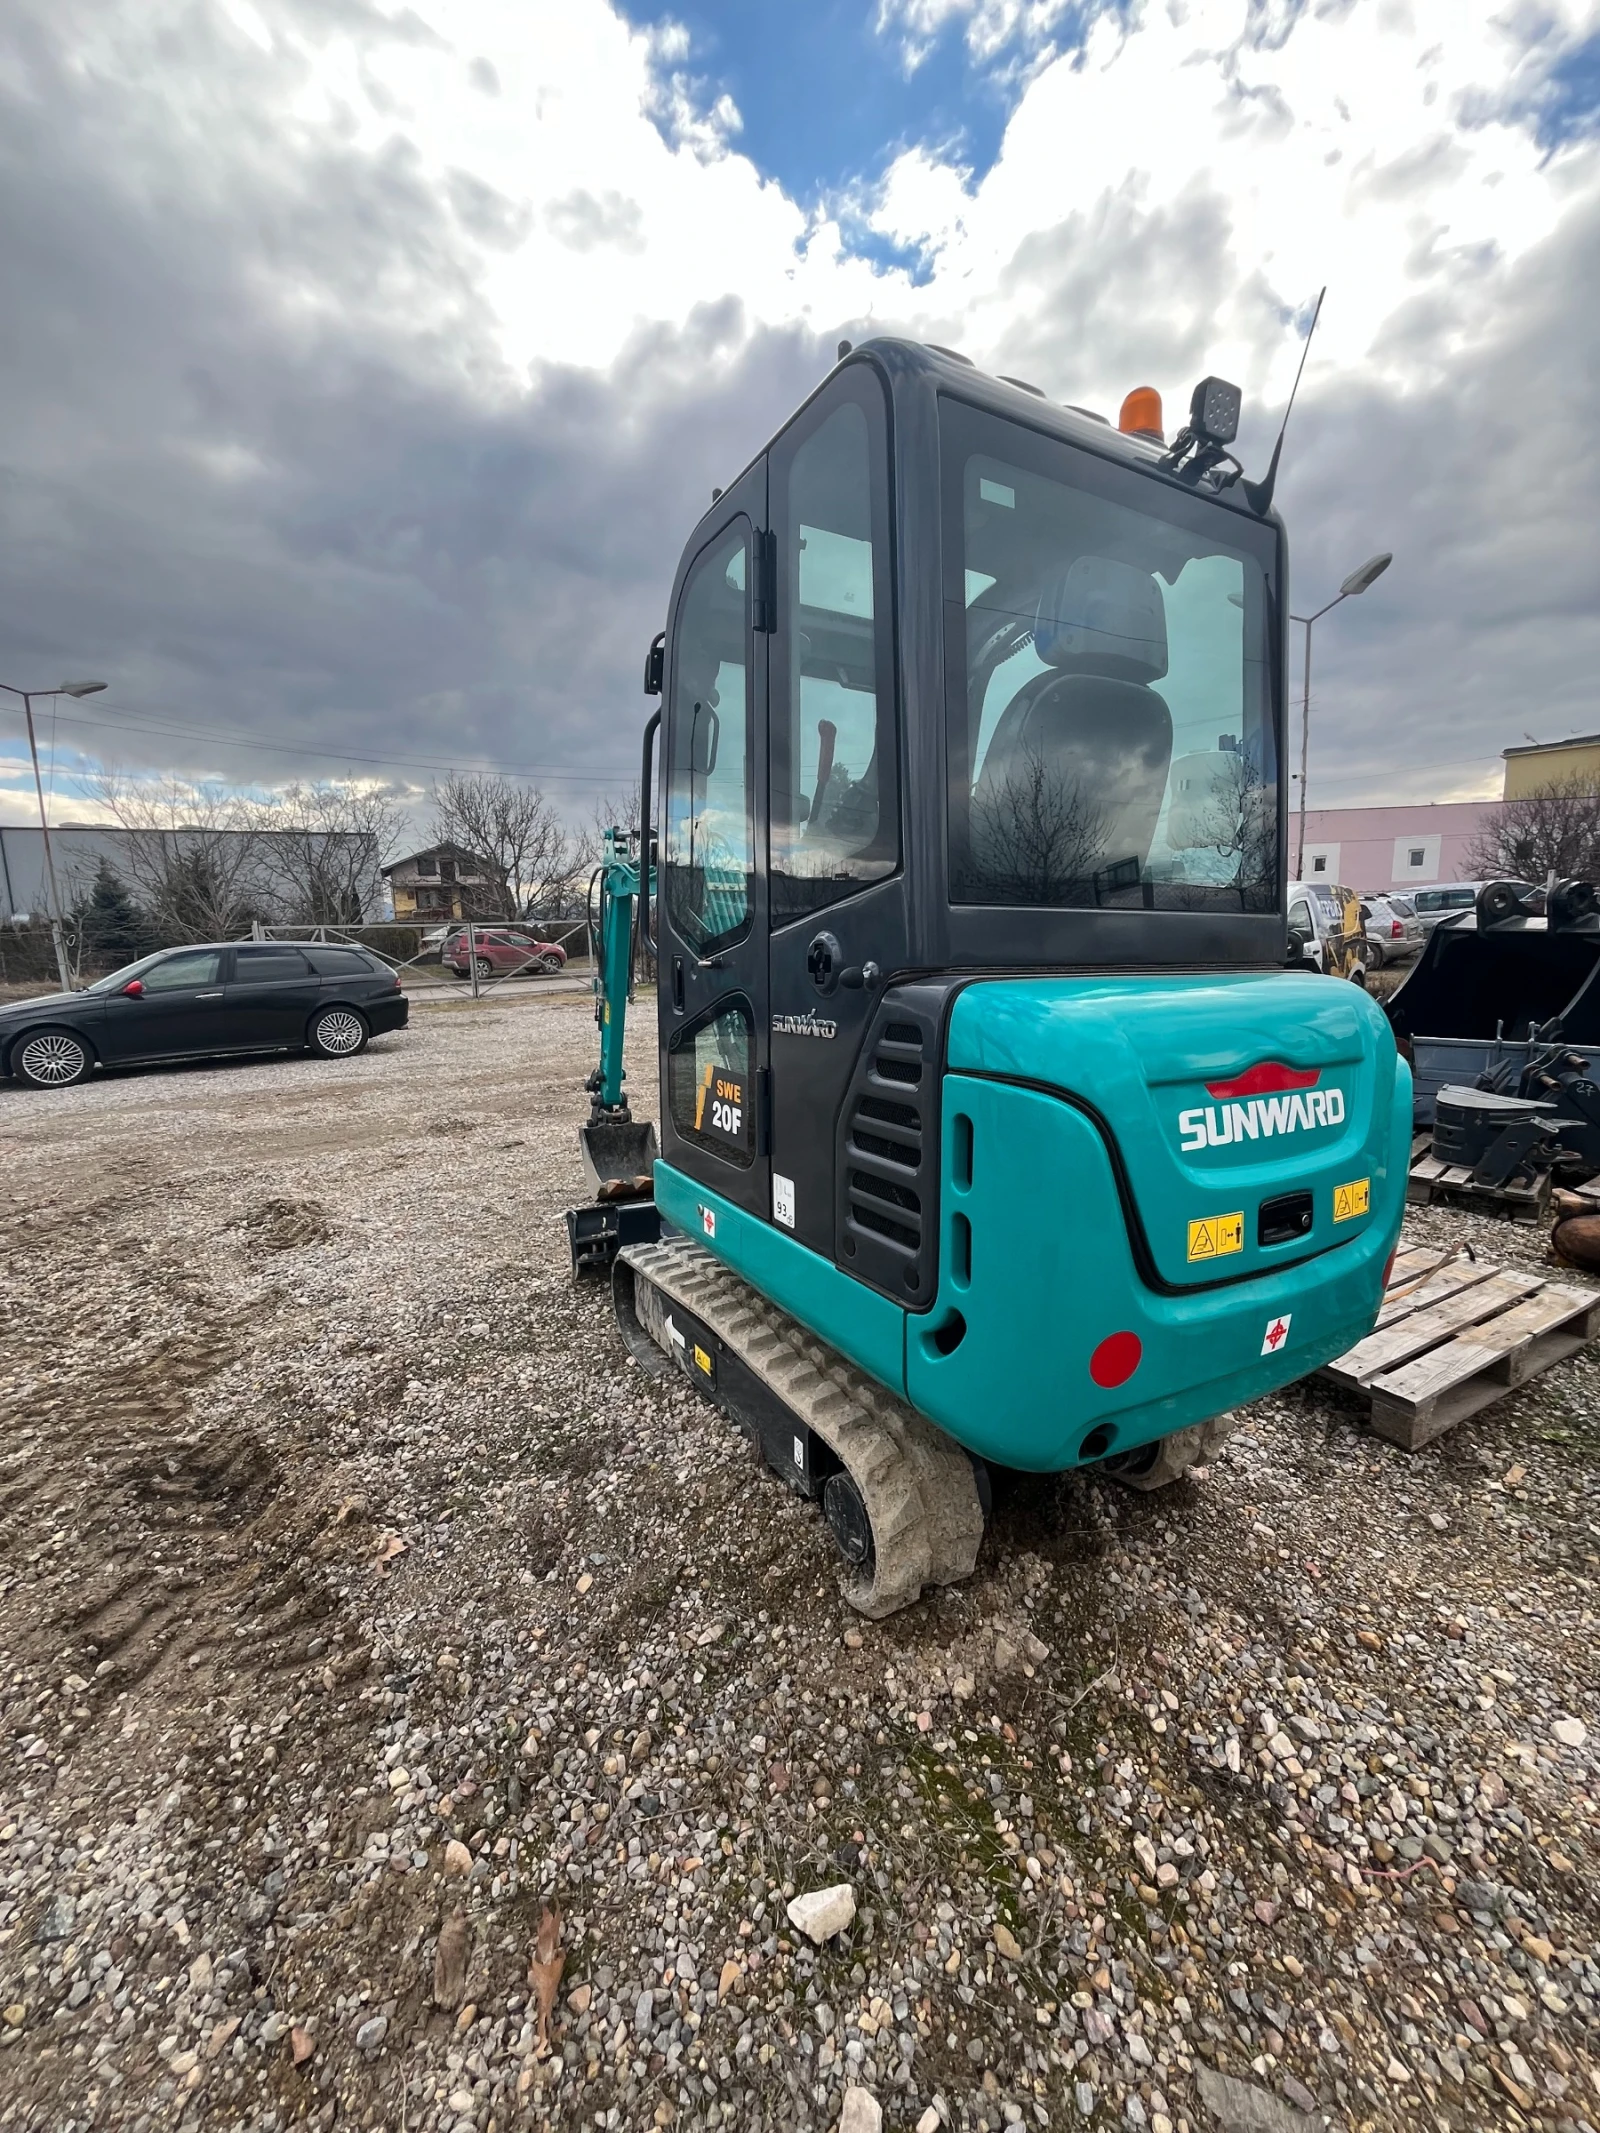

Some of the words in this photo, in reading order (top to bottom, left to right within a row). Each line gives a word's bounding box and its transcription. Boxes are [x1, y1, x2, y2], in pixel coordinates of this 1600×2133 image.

[772, 1009, 838, 1039] SUNWARD
[716, 1079, 742, 1104] SWE
[1576, 1081, 1596, 1097] 27
[712, 1100, 742, 1135] 20F
[1178, 1088, 1346, 1152] SUNWARD
[777, 1201, 788, 1217] 93
